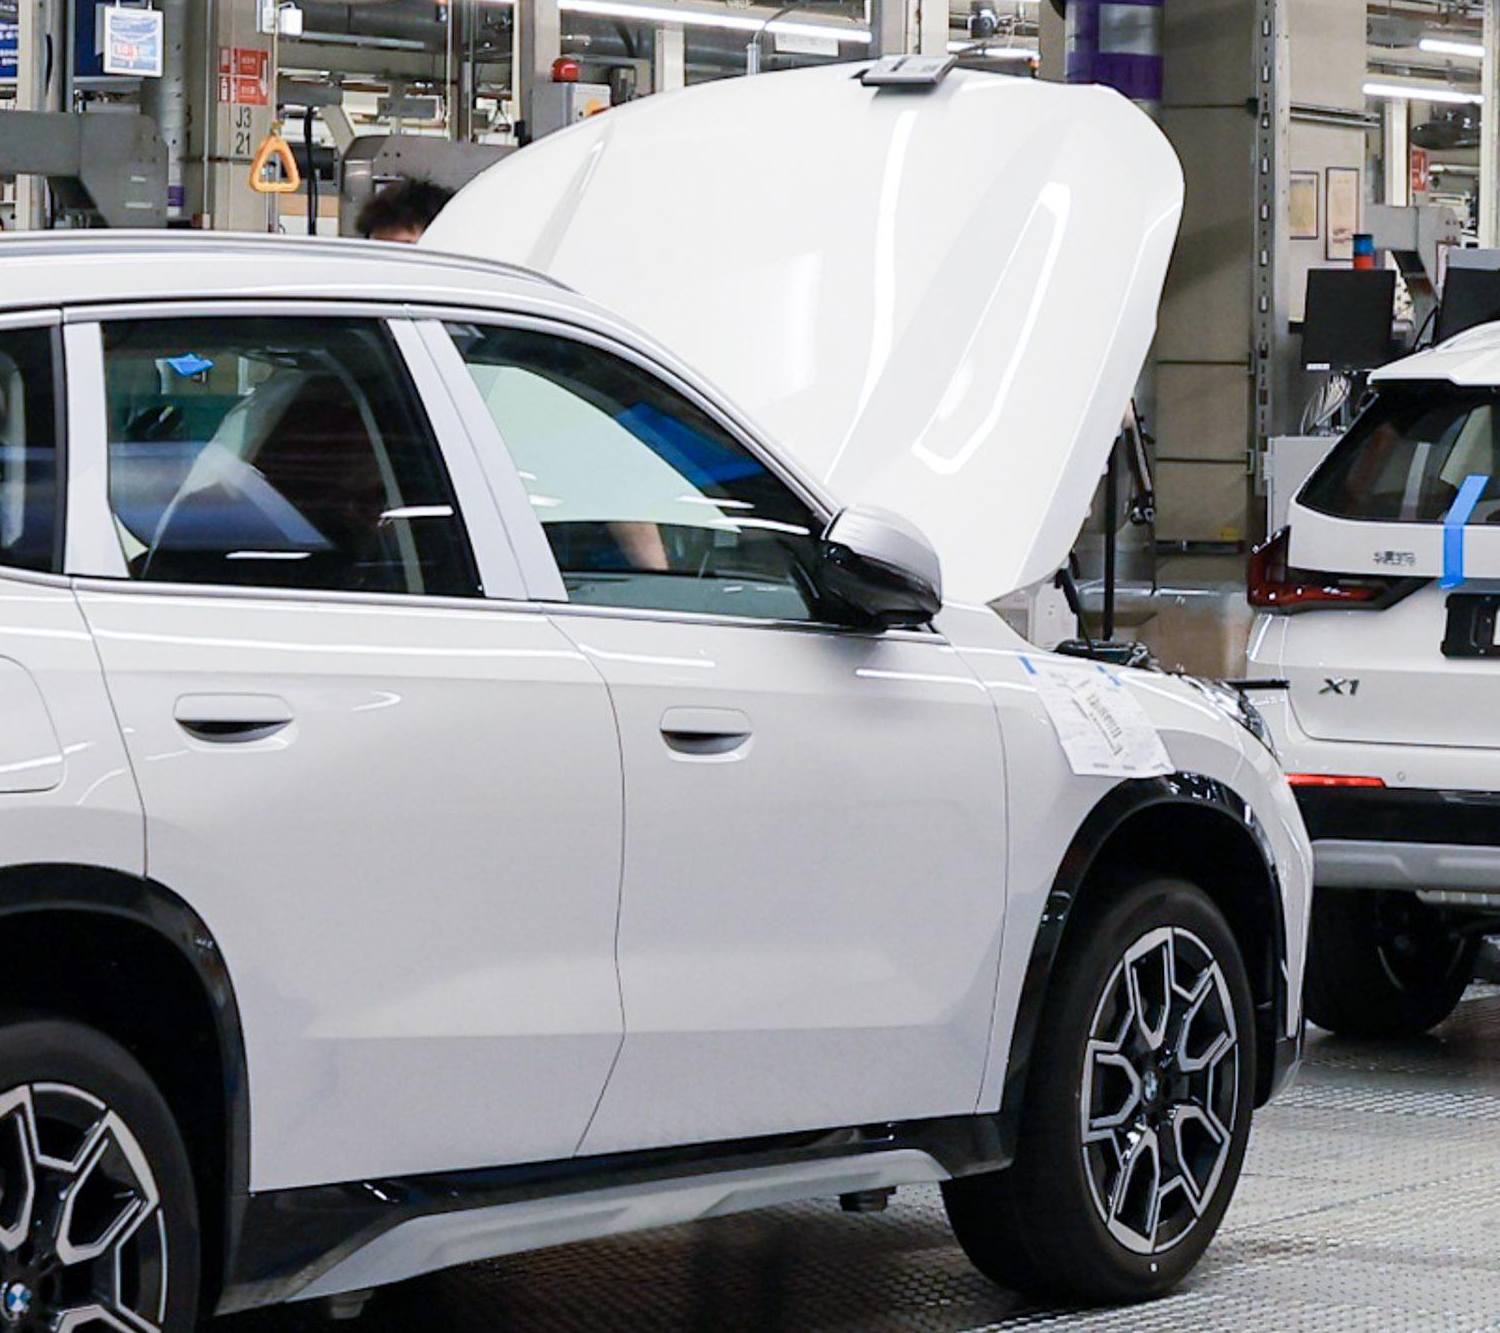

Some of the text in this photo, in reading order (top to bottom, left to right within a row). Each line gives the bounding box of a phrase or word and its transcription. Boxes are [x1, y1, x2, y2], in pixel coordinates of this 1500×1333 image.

[235, 107, 252, 128] J3
[235, 132, 251, 156] 21
[1318, 678, 1360, 696] X1
